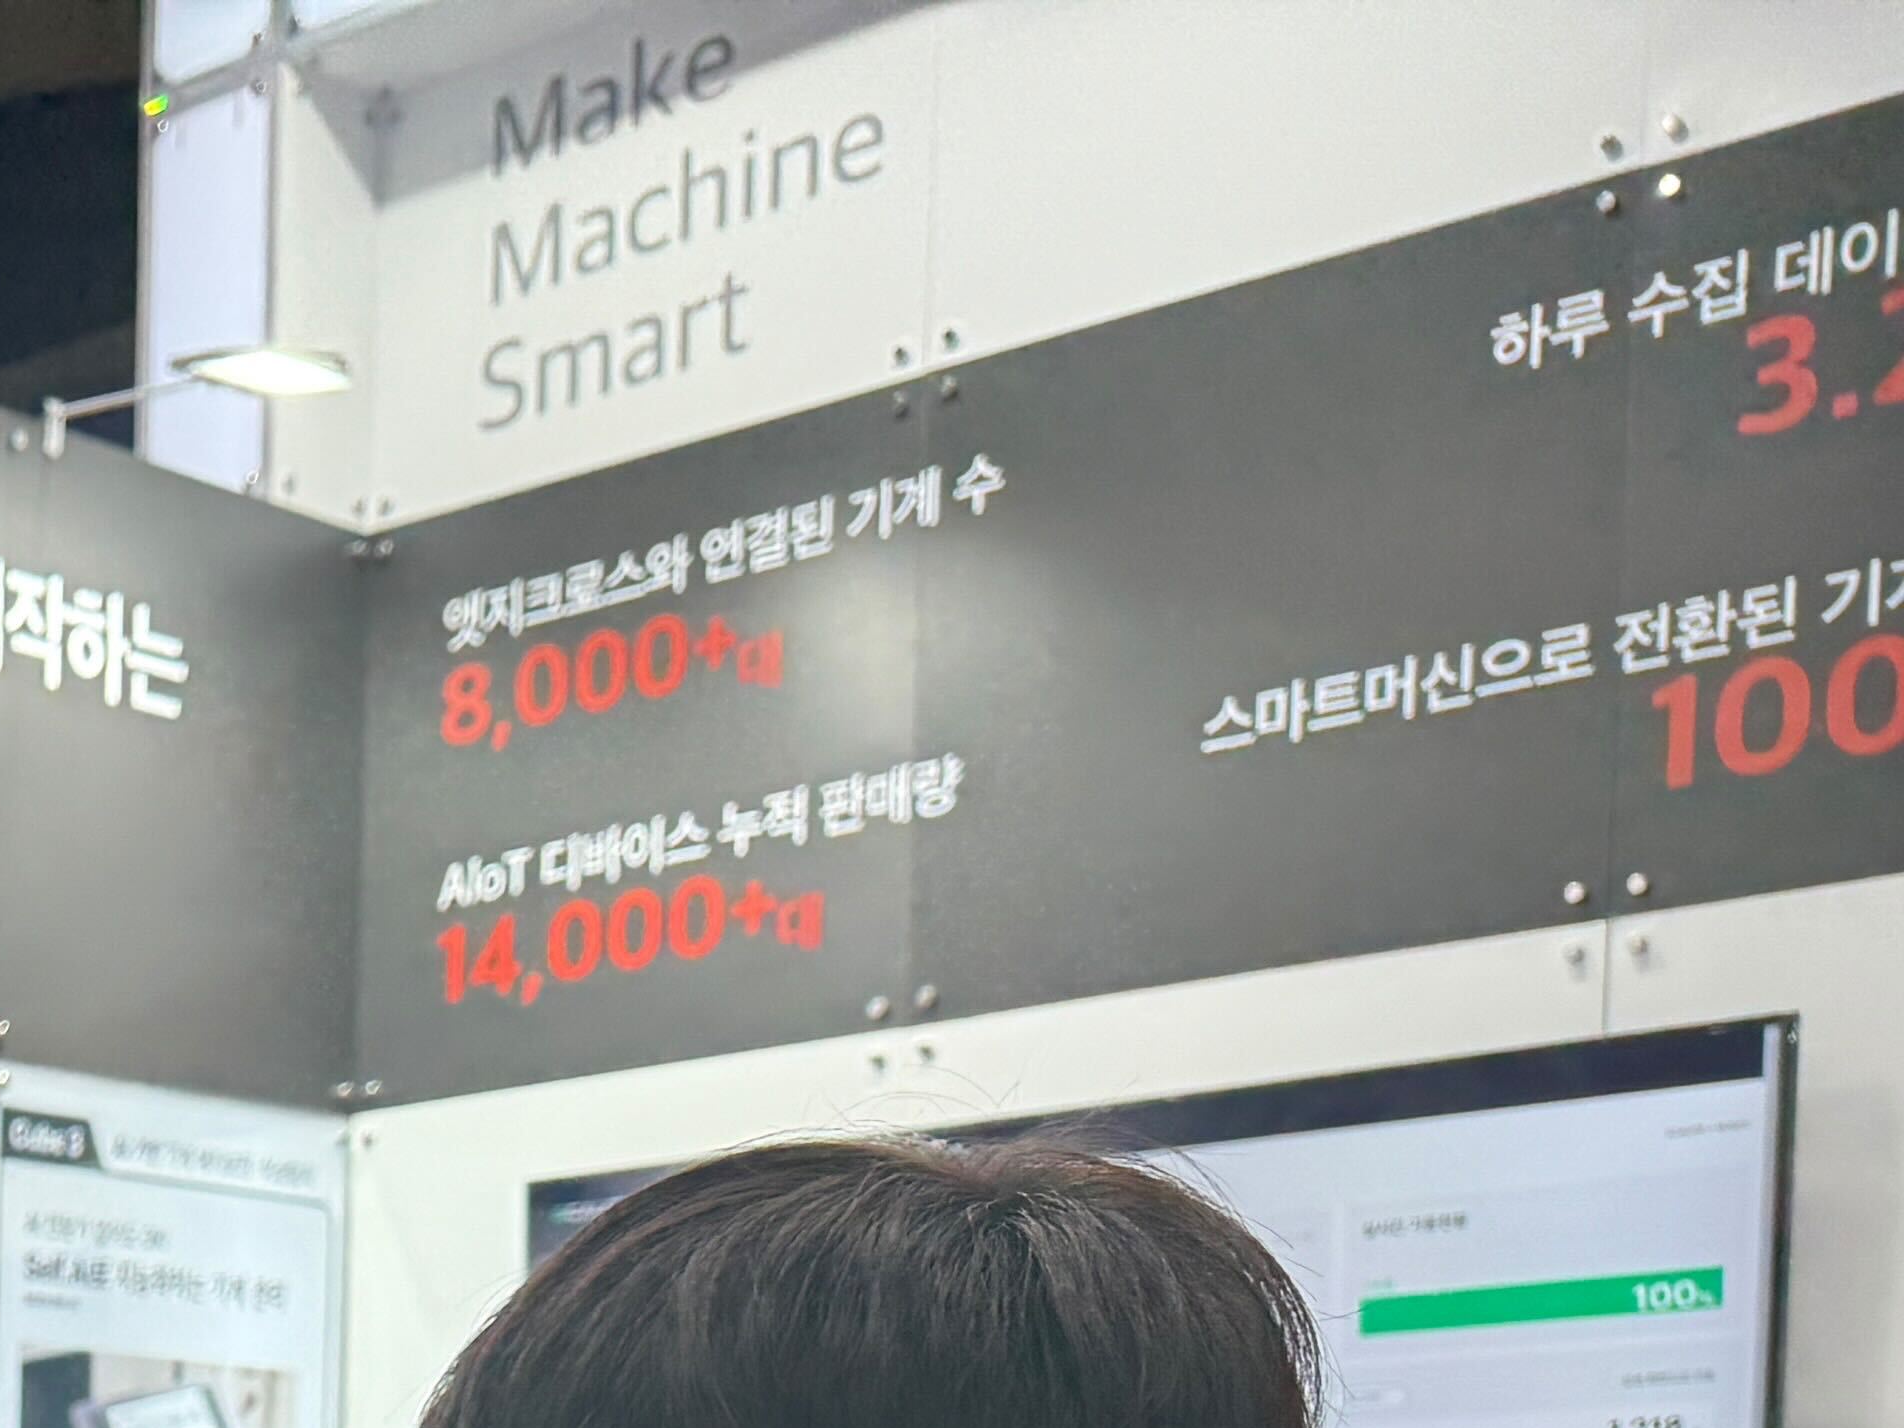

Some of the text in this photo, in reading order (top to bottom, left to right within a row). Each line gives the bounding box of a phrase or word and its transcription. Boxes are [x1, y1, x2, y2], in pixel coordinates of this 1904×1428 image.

[485, 22, 740, 178] Make
[486, 106, 886, 308] Machine
[475, 261, 752, 436] Smart
[1489, 288, 1611, 371] 하루
[1626, 246, 1750, 341] 수집
[441, 452, 1007, 653] 엣지크로스와 연결된 기계 수
[1198, 621, 1596, 755] 스마트머신으로
[1611, 574, 1798, 677] 전환된
[436, 751, 967, 913] AIoT 디바이스 누적 판매량
[9, 1117, 65, 1154] Cube
[1631, 1278, 1715, 1313] 100%
